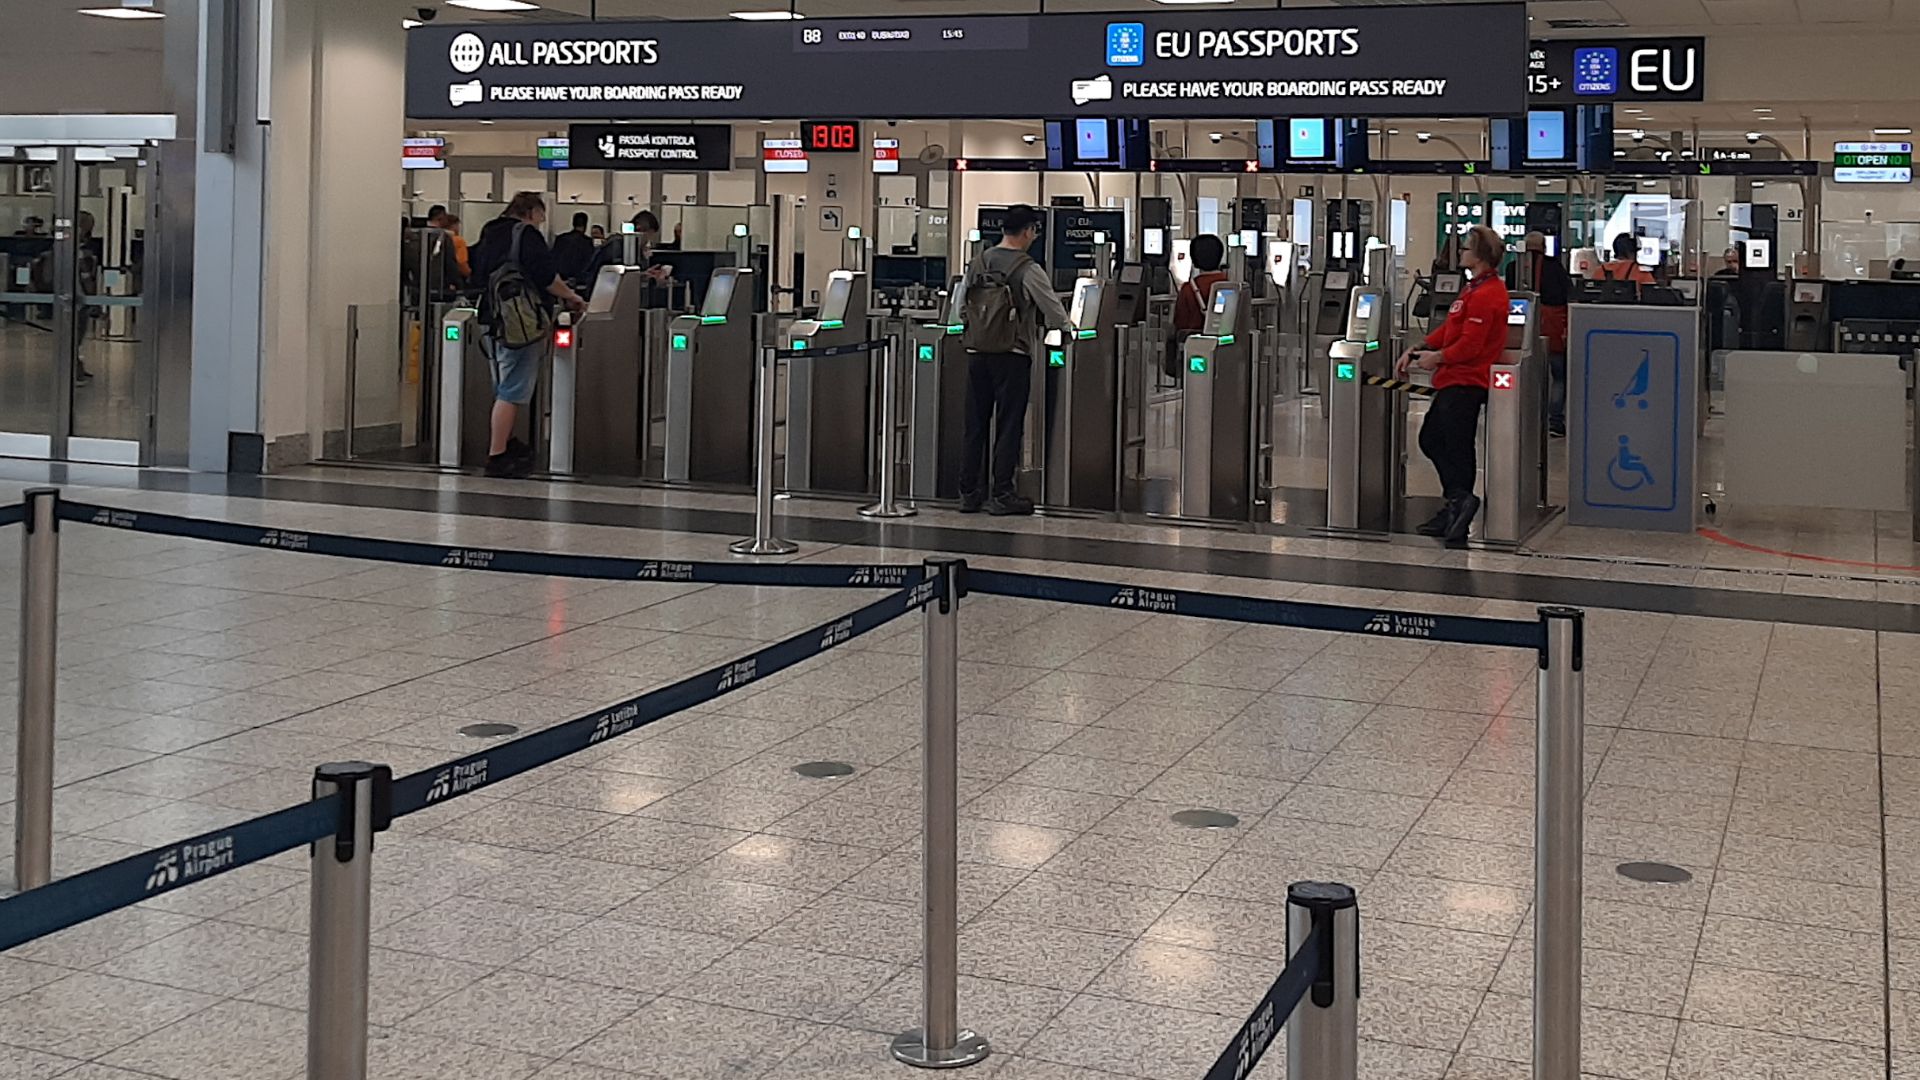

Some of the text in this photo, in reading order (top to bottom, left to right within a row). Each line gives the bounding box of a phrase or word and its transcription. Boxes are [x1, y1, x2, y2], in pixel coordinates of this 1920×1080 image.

[1156, 32, 1191, 57] EU
[1198, 28, 1359, 57] PASSPORTS
[488, 40, 658, 66] ALL PASSPORTS
[1631, 48, 1695, 91] EU
[1123, 79, 1447, 98] PLEASE HAVE YOUR BOARDING PASS READY
[1527, 75, 1562, 93] 15+
[490, 85, 744, 101] PLEASE HAVE YOUR BOARDING PASS READY
[618, 134, 696, 146] PASOVÁ KONTROLA
[618, 148, 699, 160] PASSPORT CONTROL
[1857, 155, 1889, 165] OPEN
[1138, 589, 1177, 602] Prague
[1138, 598, 1177, 611] Airport
[1395, 624, 1430, 637] Praha
[183, 835, 233, 862] Prague
[184, 850, 234, 878] Airport
